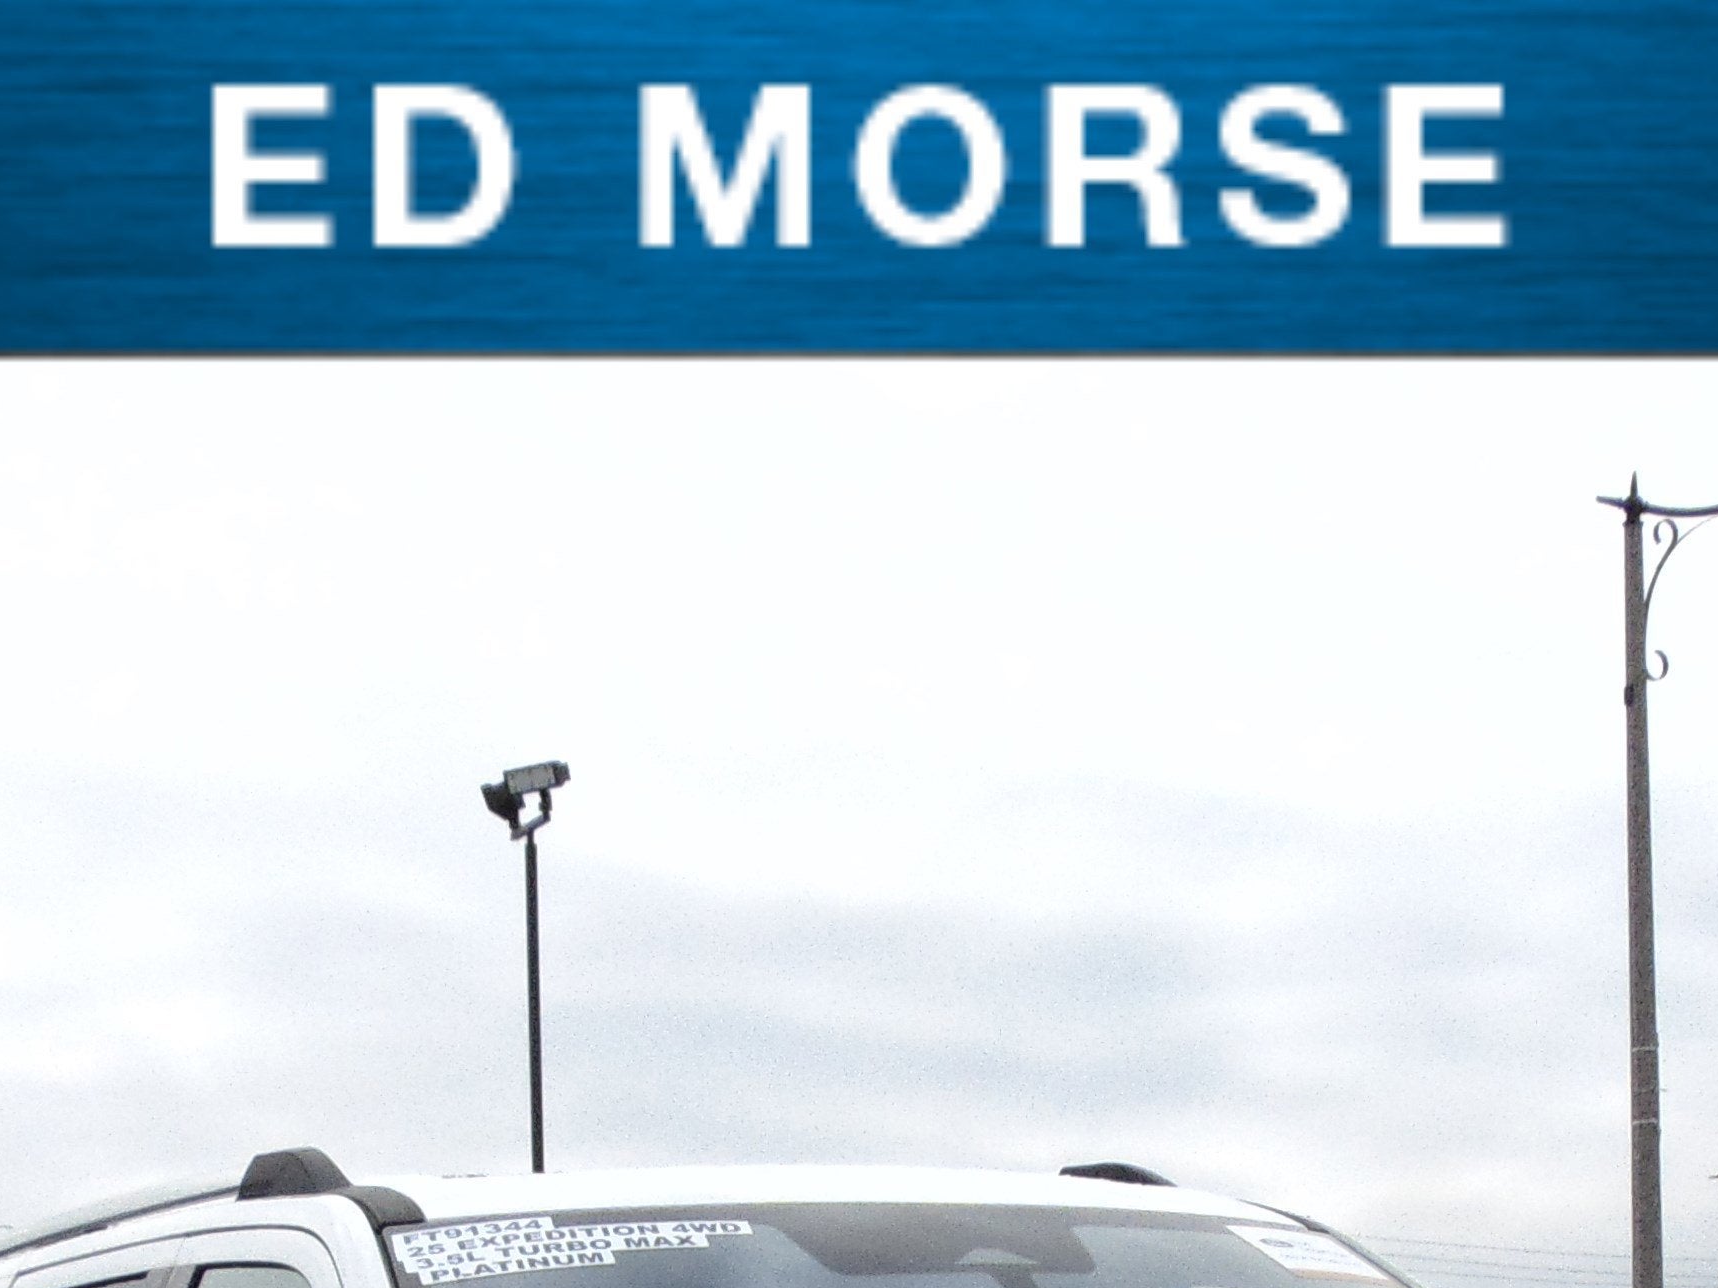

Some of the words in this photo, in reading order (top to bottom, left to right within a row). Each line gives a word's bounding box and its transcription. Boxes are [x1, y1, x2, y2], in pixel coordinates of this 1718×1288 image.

[407, 1243, 446, 1258] 25
[457, 1224, 660, 1251] EXPEDITION
[671, 1222, 742, 1233] 4WD
[416, 1251, 486, 1270] 3.5L
[494, 1238, 612, 1258] TURBO
[623, 1235, 697, 1248] MAX
[430, 1252, 604, 1281] PLATINUM
